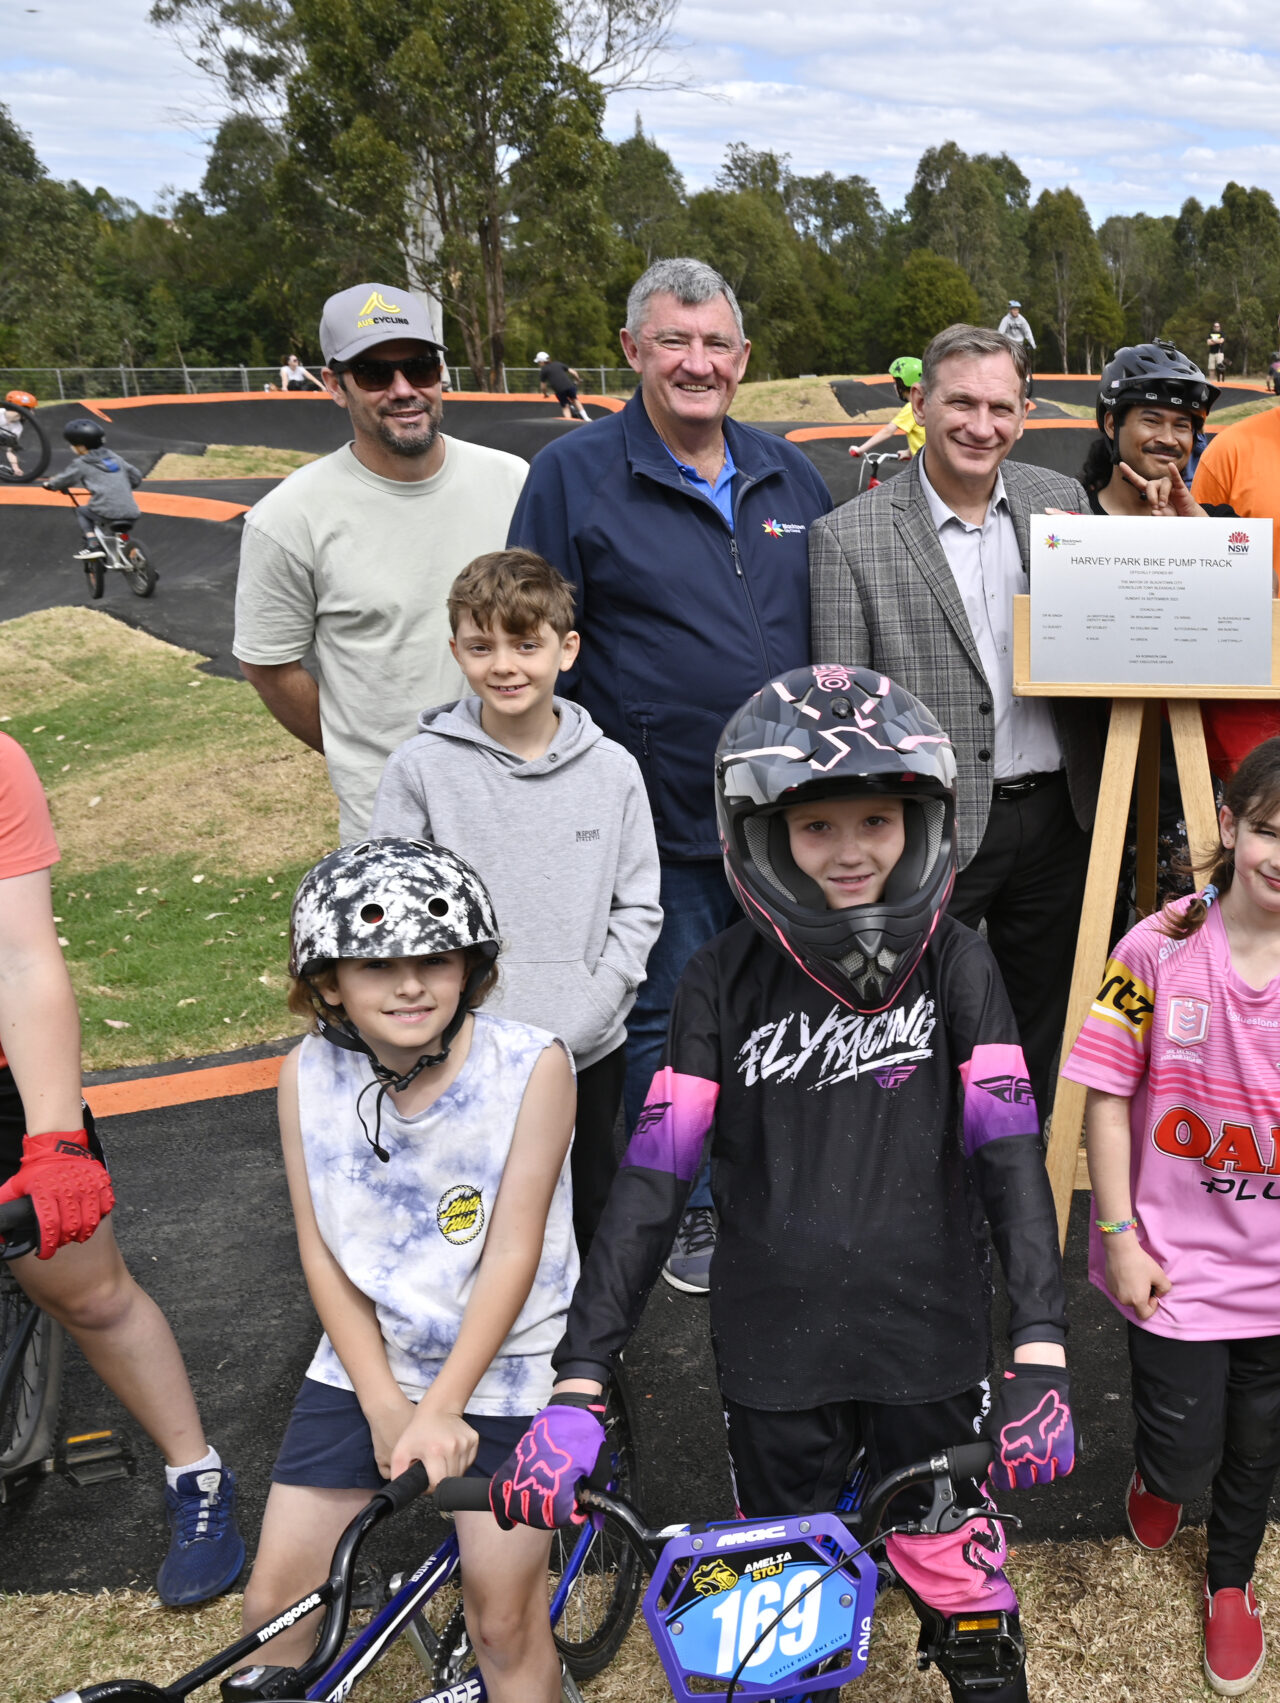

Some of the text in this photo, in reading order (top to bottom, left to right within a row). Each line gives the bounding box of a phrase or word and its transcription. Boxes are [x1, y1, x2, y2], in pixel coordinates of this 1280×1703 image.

[358, 317, 409, 328] AUSCYCLING
[1228, 545, 1249, 553] NSW
[1071, 557, 1233, 568] HARVEY PARK BIKE PUMP TRACK
[1096, 975, 1155, 1026] rtz
[744, 1551, 792, 1574] AMELIA
[752, 1562, 784, 1582] STOJ
[257, 1593, 322, 1643] mongoose
[712, 1569, 822, 1675] 169
[857, 1616, 872, 1661] ONE
